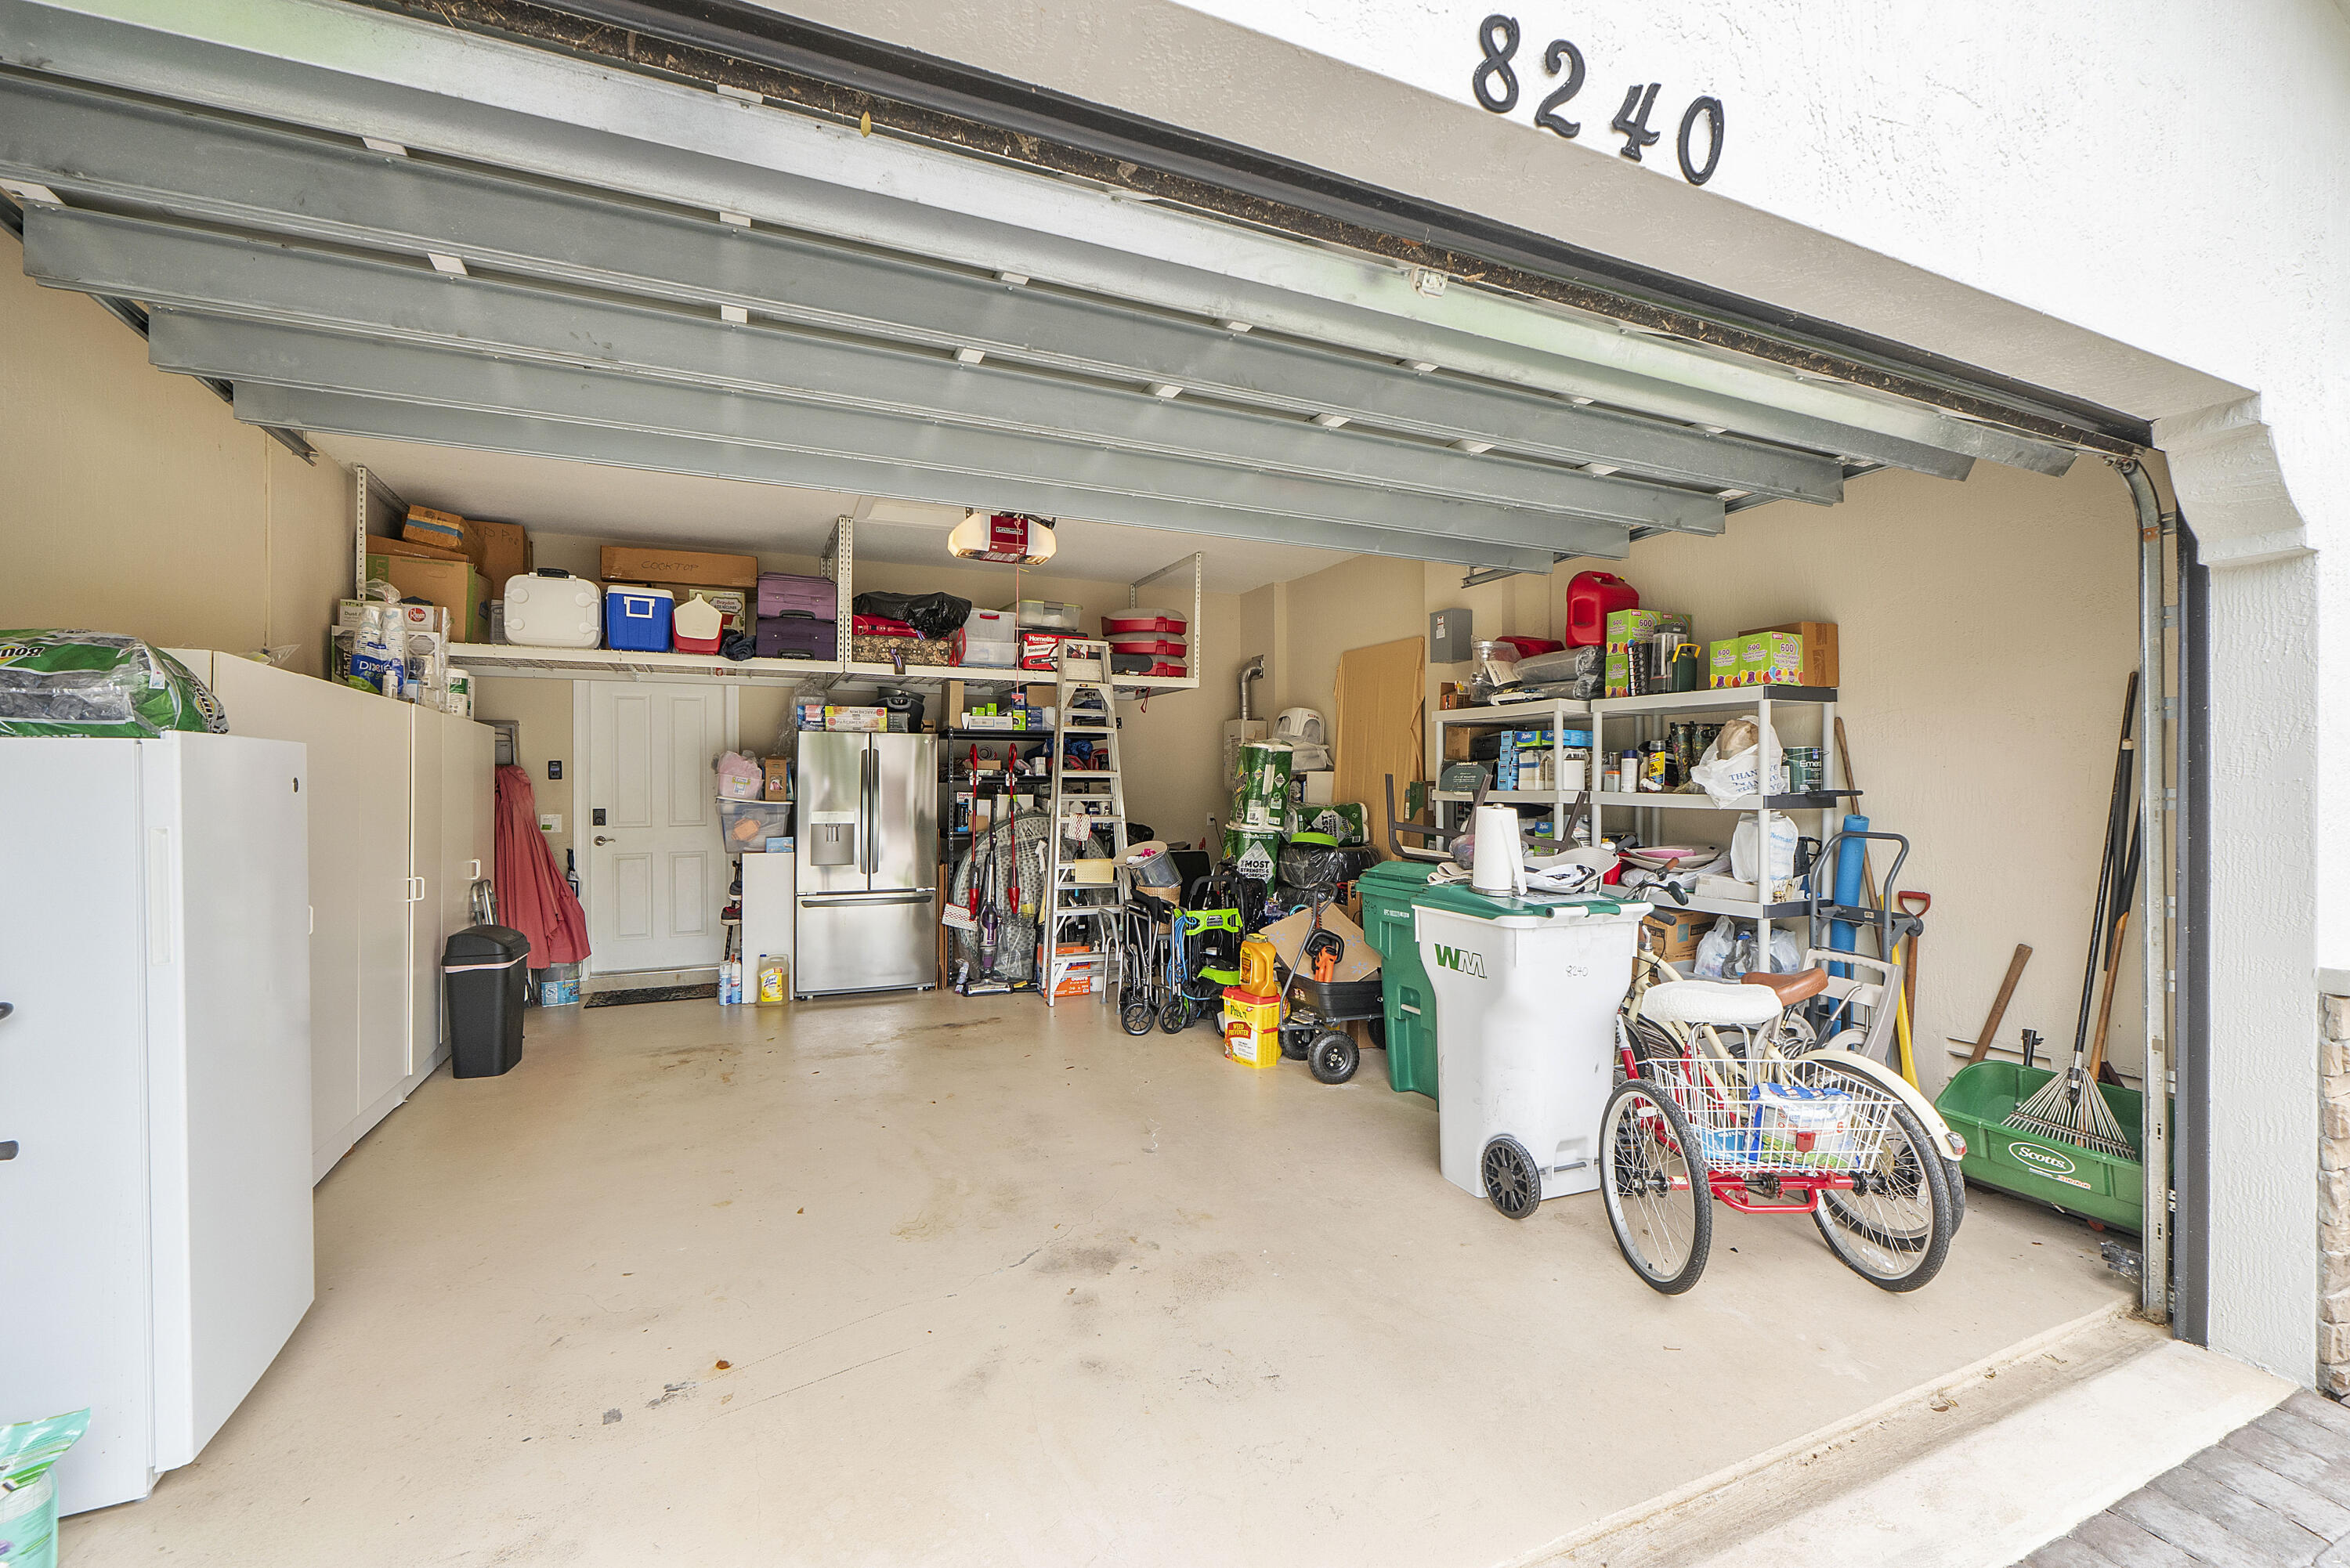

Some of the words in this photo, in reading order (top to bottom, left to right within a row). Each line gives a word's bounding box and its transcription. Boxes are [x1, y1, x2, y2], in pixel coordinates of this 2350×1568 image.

[1473, 13, 1725, 186] 8240
[641, 560, 700, 571] COOKTOP
[0, 646, 45, 657] Bou
[1781, 643, 1794, 652] 600
[1729, 768, 1759, 781] THAN
[1246, 860, 1270, 869] MOST
[1434, 943, 1485, 979] WM
[1566, 965, 1589, 977] 8240
[1230, 1005, 1247, 1018] Preen
[2018, 1147, 2066, 1169] Scotts
